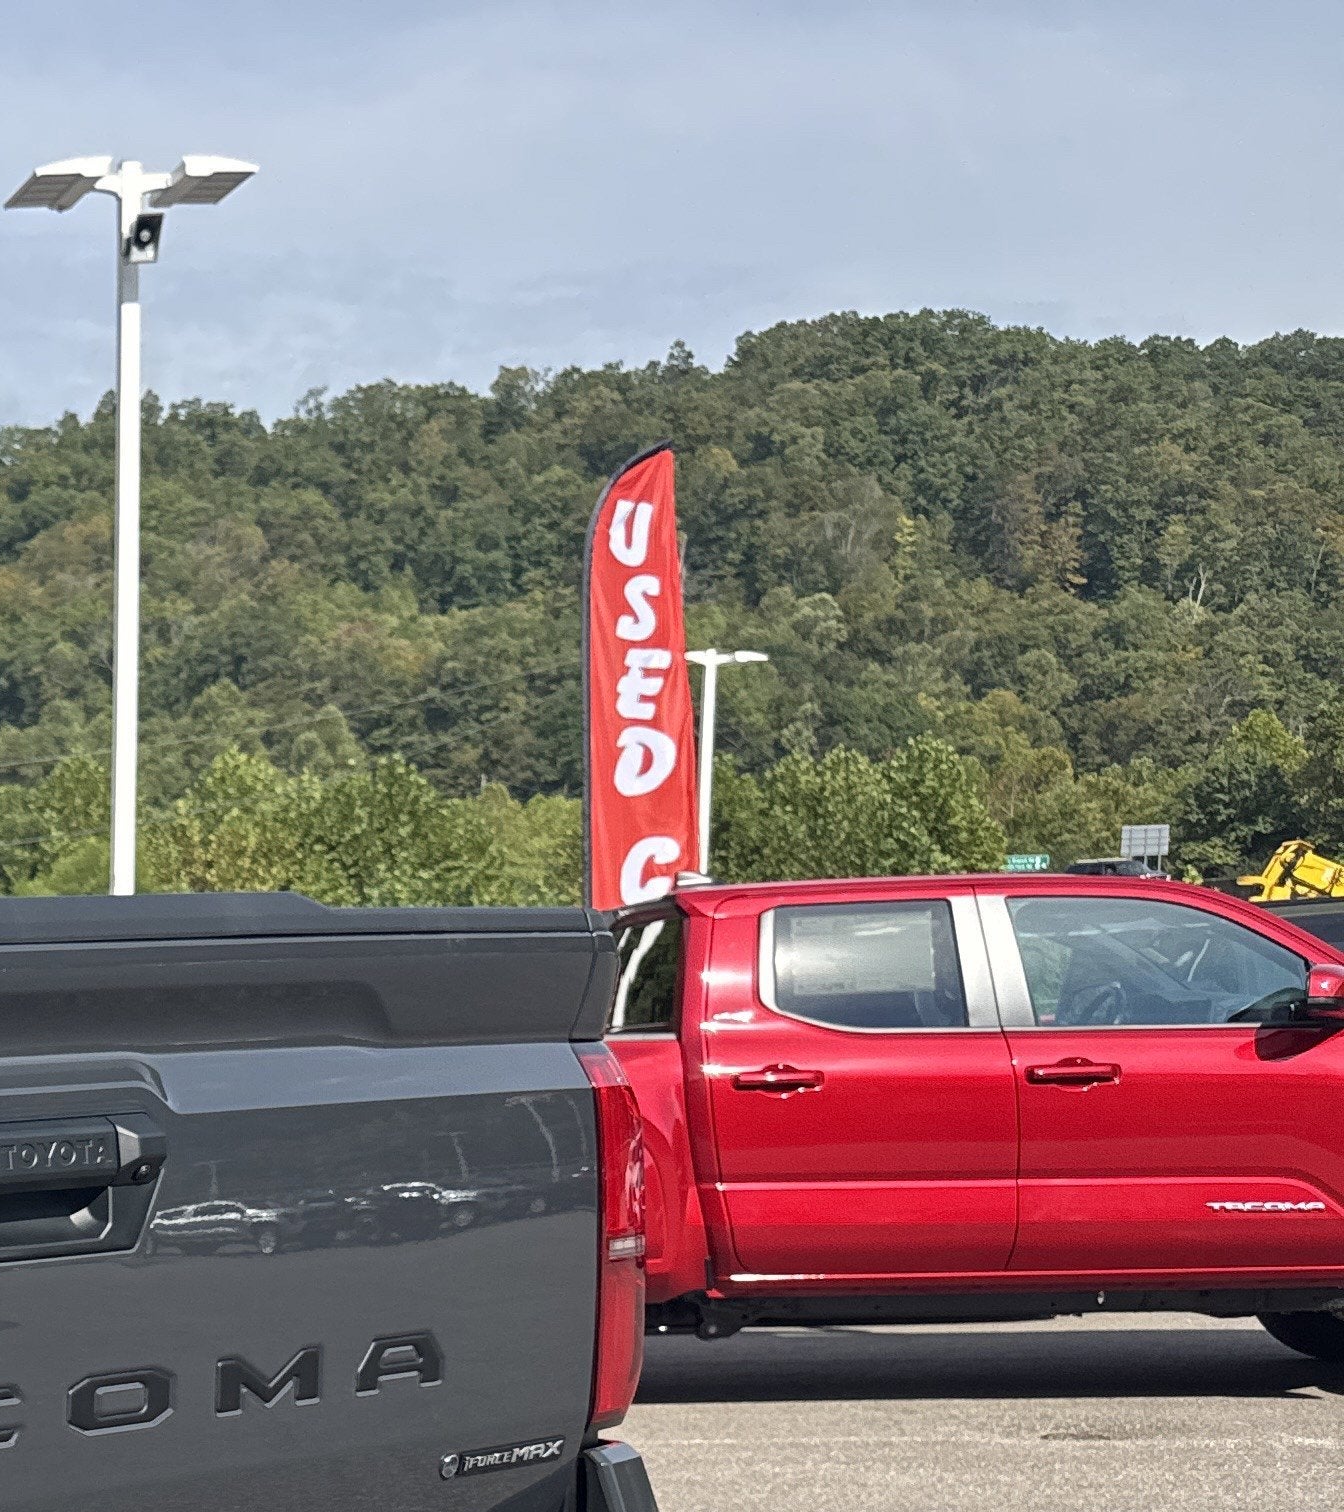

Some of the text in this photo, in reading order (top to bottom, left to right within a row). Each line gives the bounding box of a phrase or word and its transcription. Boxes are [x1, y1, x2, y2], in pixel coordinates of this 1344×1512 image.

[608, 499, 677, 798] USED
[0, 1138, 113, 1171] TOYOTA
[1204, 1201, 1326, 1213] TACOMA
[511, 1439, 564, 1463] MAX
